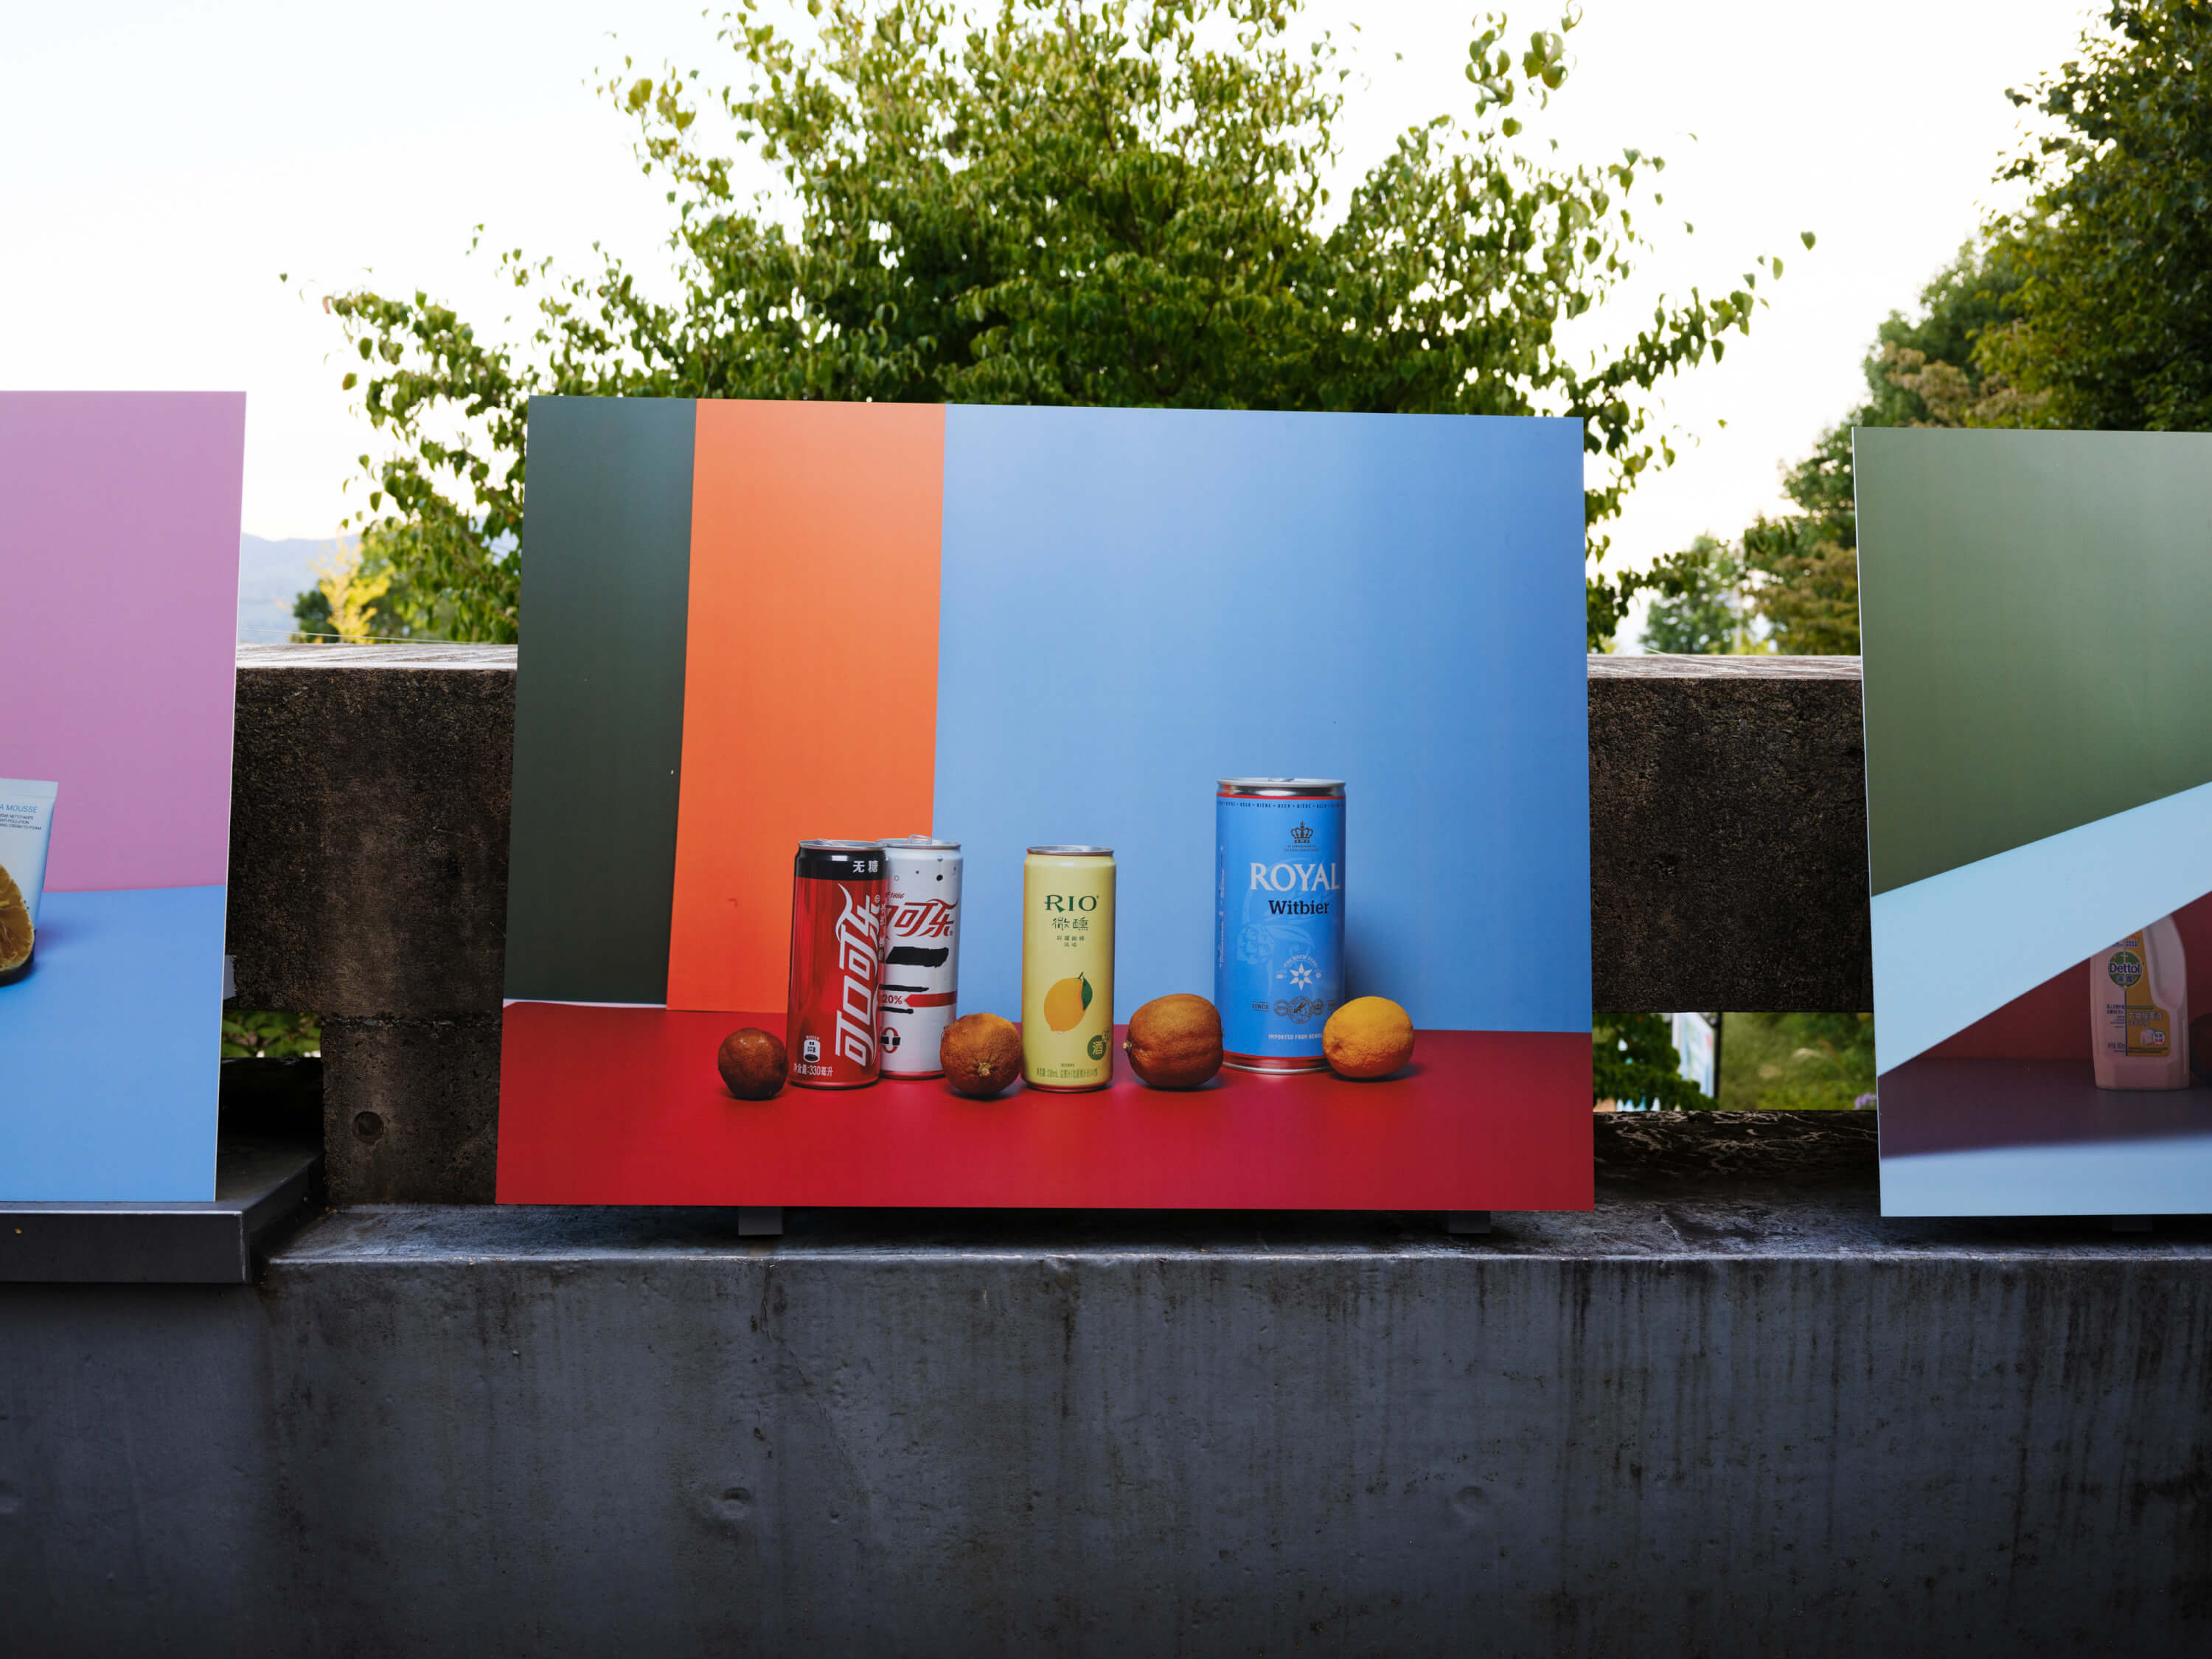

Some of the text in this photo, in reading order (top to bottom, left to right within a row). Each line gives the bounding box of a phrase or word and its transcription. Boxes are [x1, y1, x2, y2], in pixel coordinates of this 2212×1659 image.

[6, 804, 38, 813] MOUSSE
[852, 860, 879, 873] 无糖
[1251, 863, 1340, 891] ROYAL
[1044, 894, 1097, 913] RIO
[1268, 900, 1330, 915] Witbier
[835, 883, 880, 1068] 可口可乐
[2109, 962, 2140, 974] Dettol
[1092, 1040, 1104, 1056] 酒
